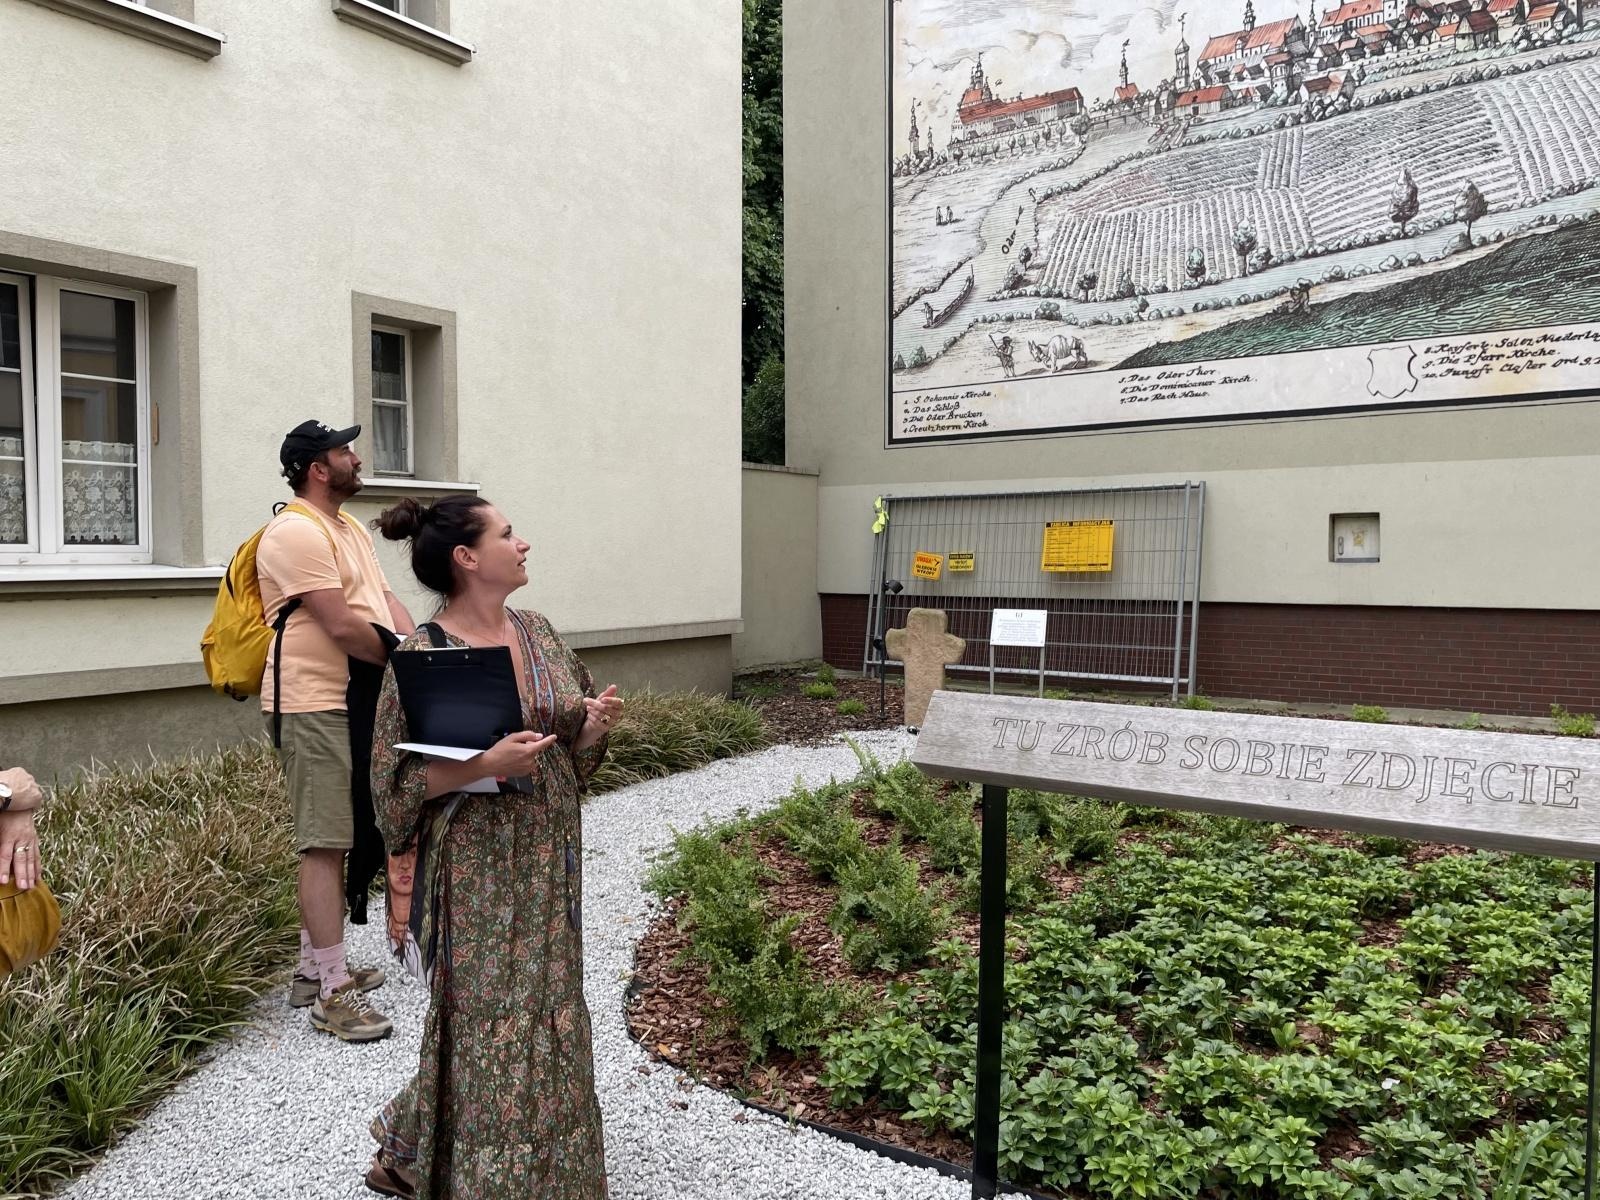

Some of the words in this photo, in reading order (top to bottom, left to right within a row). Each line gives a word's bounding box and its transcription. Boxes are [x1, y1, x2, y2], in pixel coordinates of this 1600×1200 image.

[1438, 355, 1460, 365] Die
[1127, 374, 1151, 383] Das
[1156, 370, 1186, 380] Oder
[1127, 396, 1150, 404] Das
[913, 406, 932, 414] Das
[993, 717, 1046, 751] TU
[1051, 721, 1169, 765] ZRÓB
[1180, 735, 1330, 783] SOBIE
[1342, 749, 1581, 808] ZDJĘCIE
